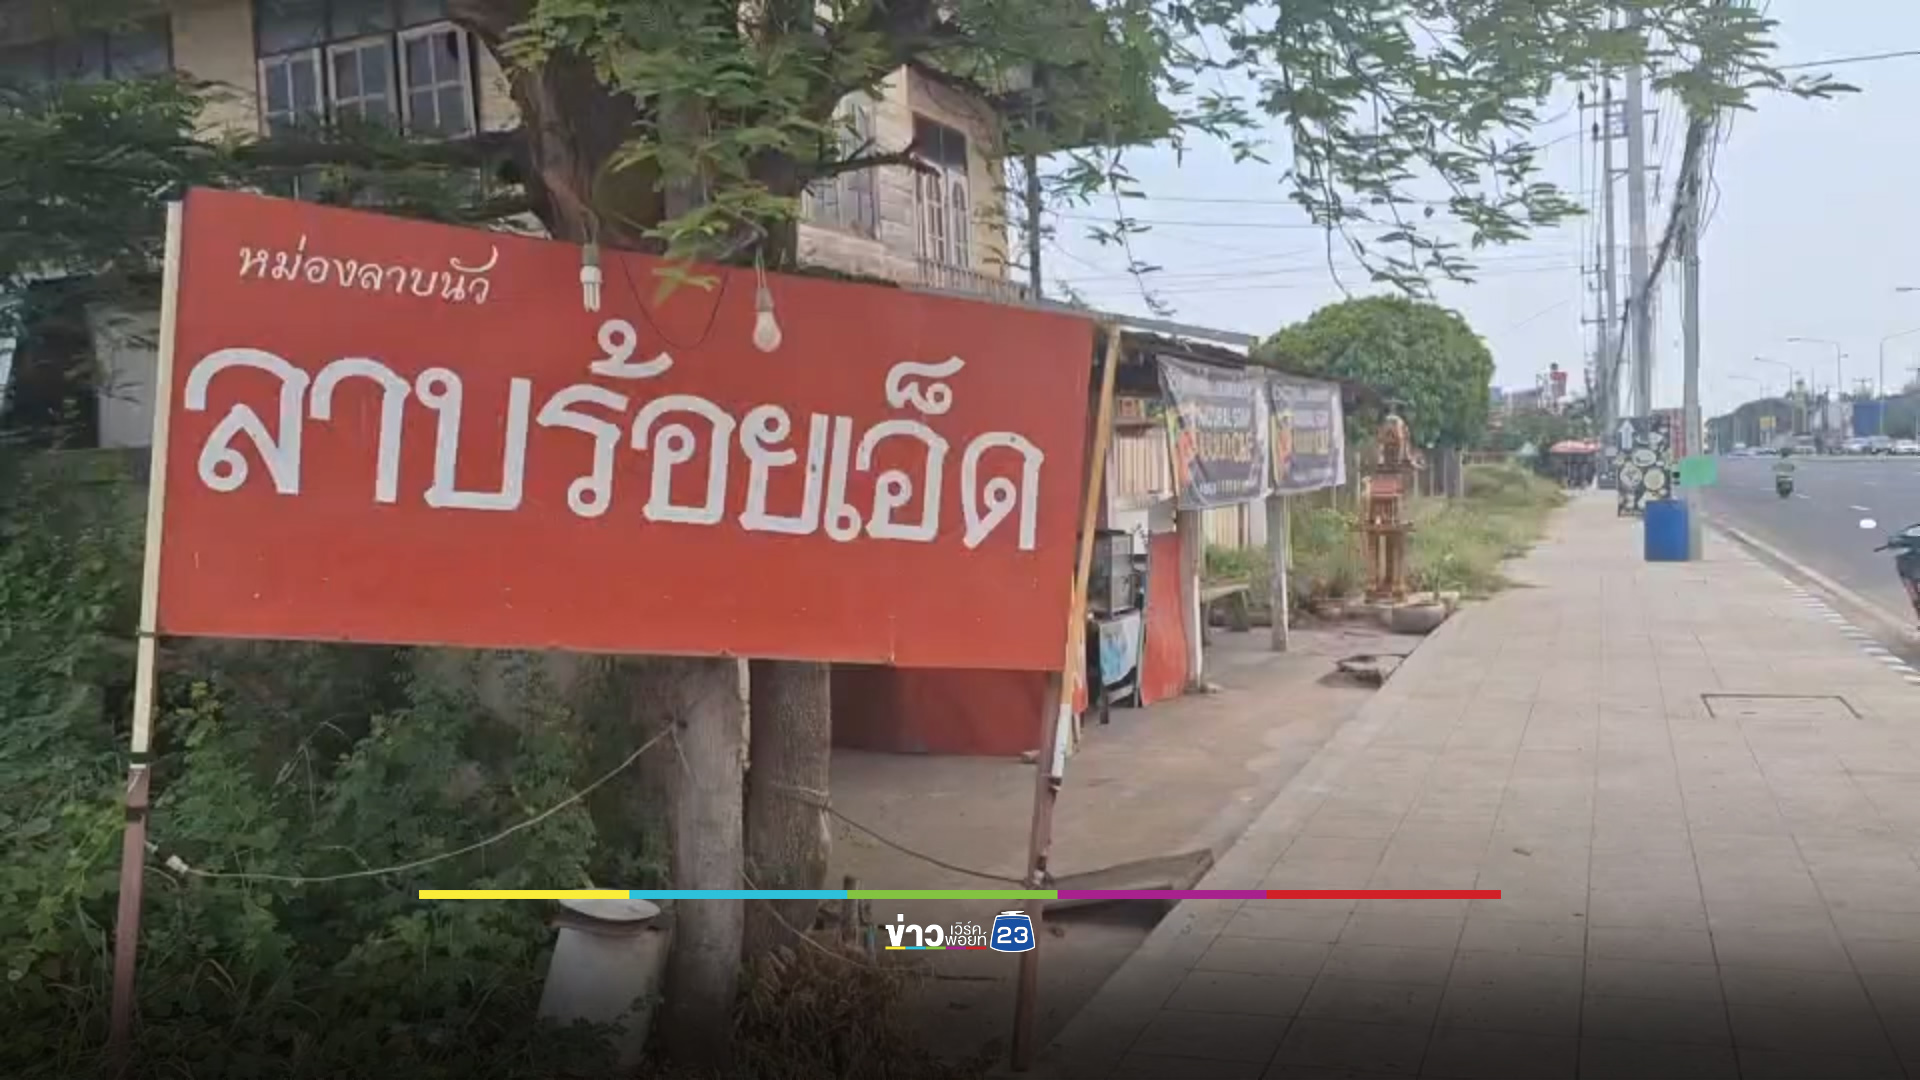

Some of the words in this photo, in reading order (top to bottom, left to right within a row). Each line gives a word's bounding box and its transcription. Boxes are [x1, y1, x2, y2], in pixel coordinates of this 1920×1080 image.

[238, 234, 500, 305] หม่องลาบนัว
[183, 318, 1044, 551] ลาบร้อยเอ็ด
